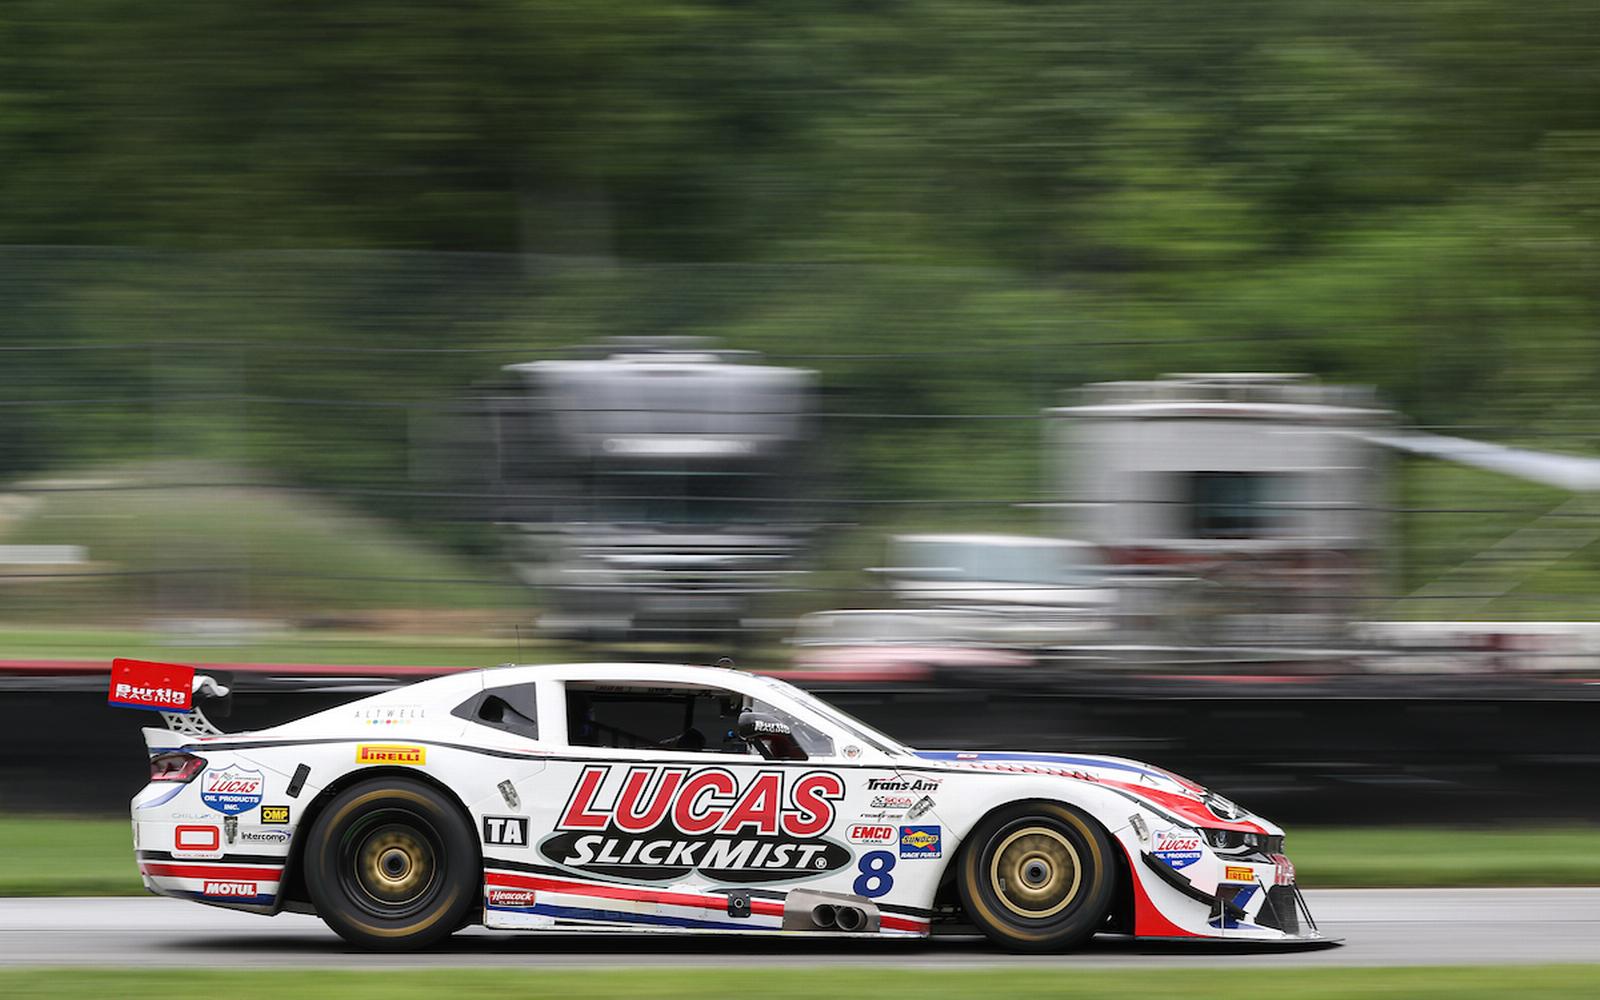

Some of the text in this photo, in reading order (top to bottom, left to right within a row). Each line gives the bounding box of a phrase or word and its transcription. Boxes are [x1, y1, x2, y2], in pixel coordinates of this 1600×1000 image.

[115, 692, 185, 704] RACING
[116, 684, 186, 700] Burtin
[362, 748, 420, 761] PIRELLI
[208, 780, 259, 793] LUCAS
[556, 765, 845, 836] LUCAS
[263, 810, 288, 821] OMP
[241, 831, 286, 842] Intercomp
[487, 819, 523, 844] TA
[852, 826, 892, 839] EMCO
[1158, 839, 1199, 851] LUCAS
[853, 850, 896, 898] 8
[206, 883, 255, 895] MOTUL
[491, 891, 534, 901] Heacock
